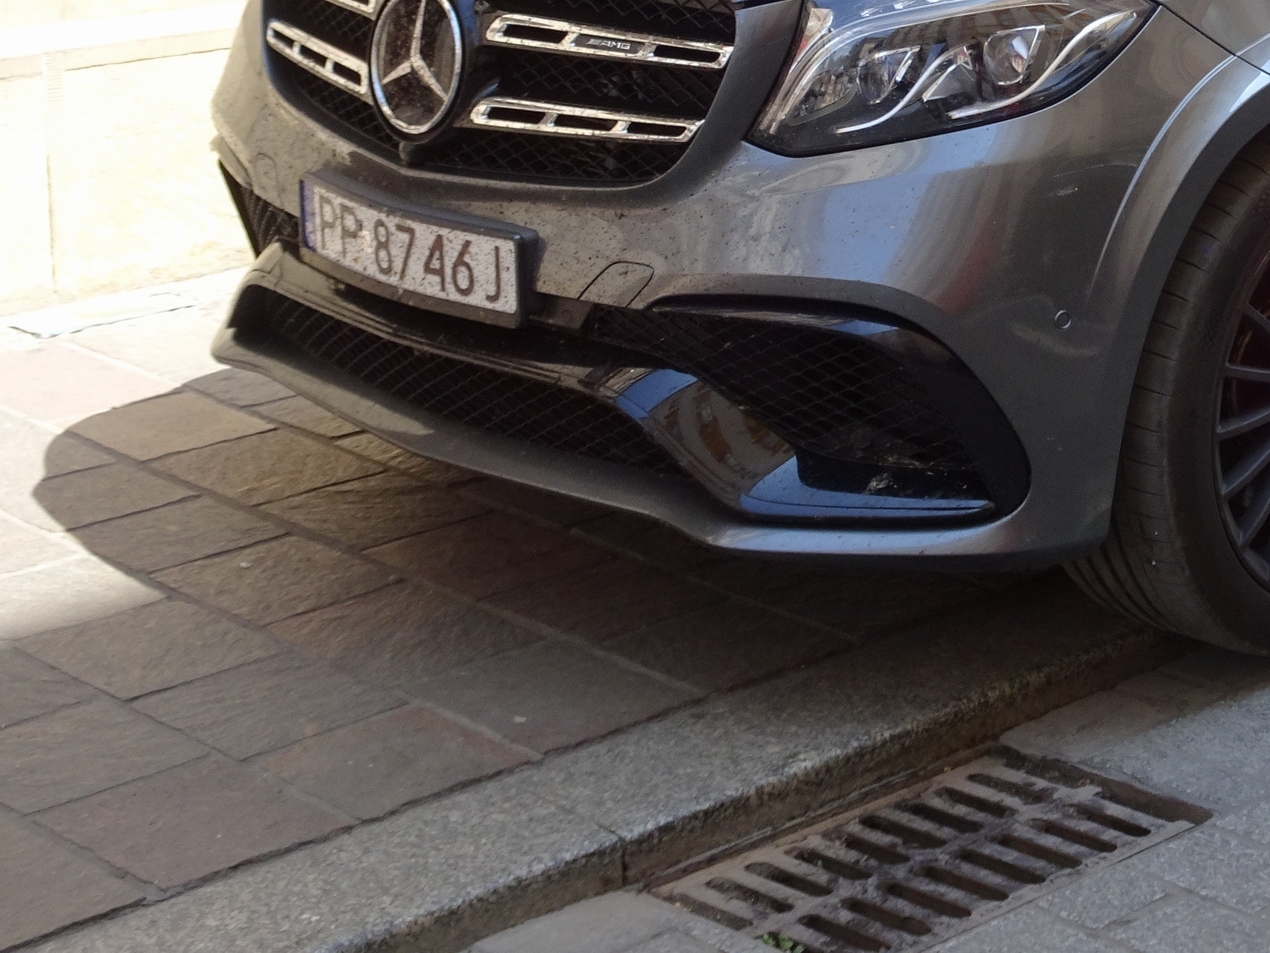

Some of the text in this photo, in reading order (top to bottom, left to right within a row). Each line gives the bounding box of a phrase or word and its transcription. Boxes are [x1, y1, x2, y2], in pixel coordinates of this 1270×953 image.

[599, 39, 631, 50] AMG
[318, 195, 501, 304] PP 8746J
